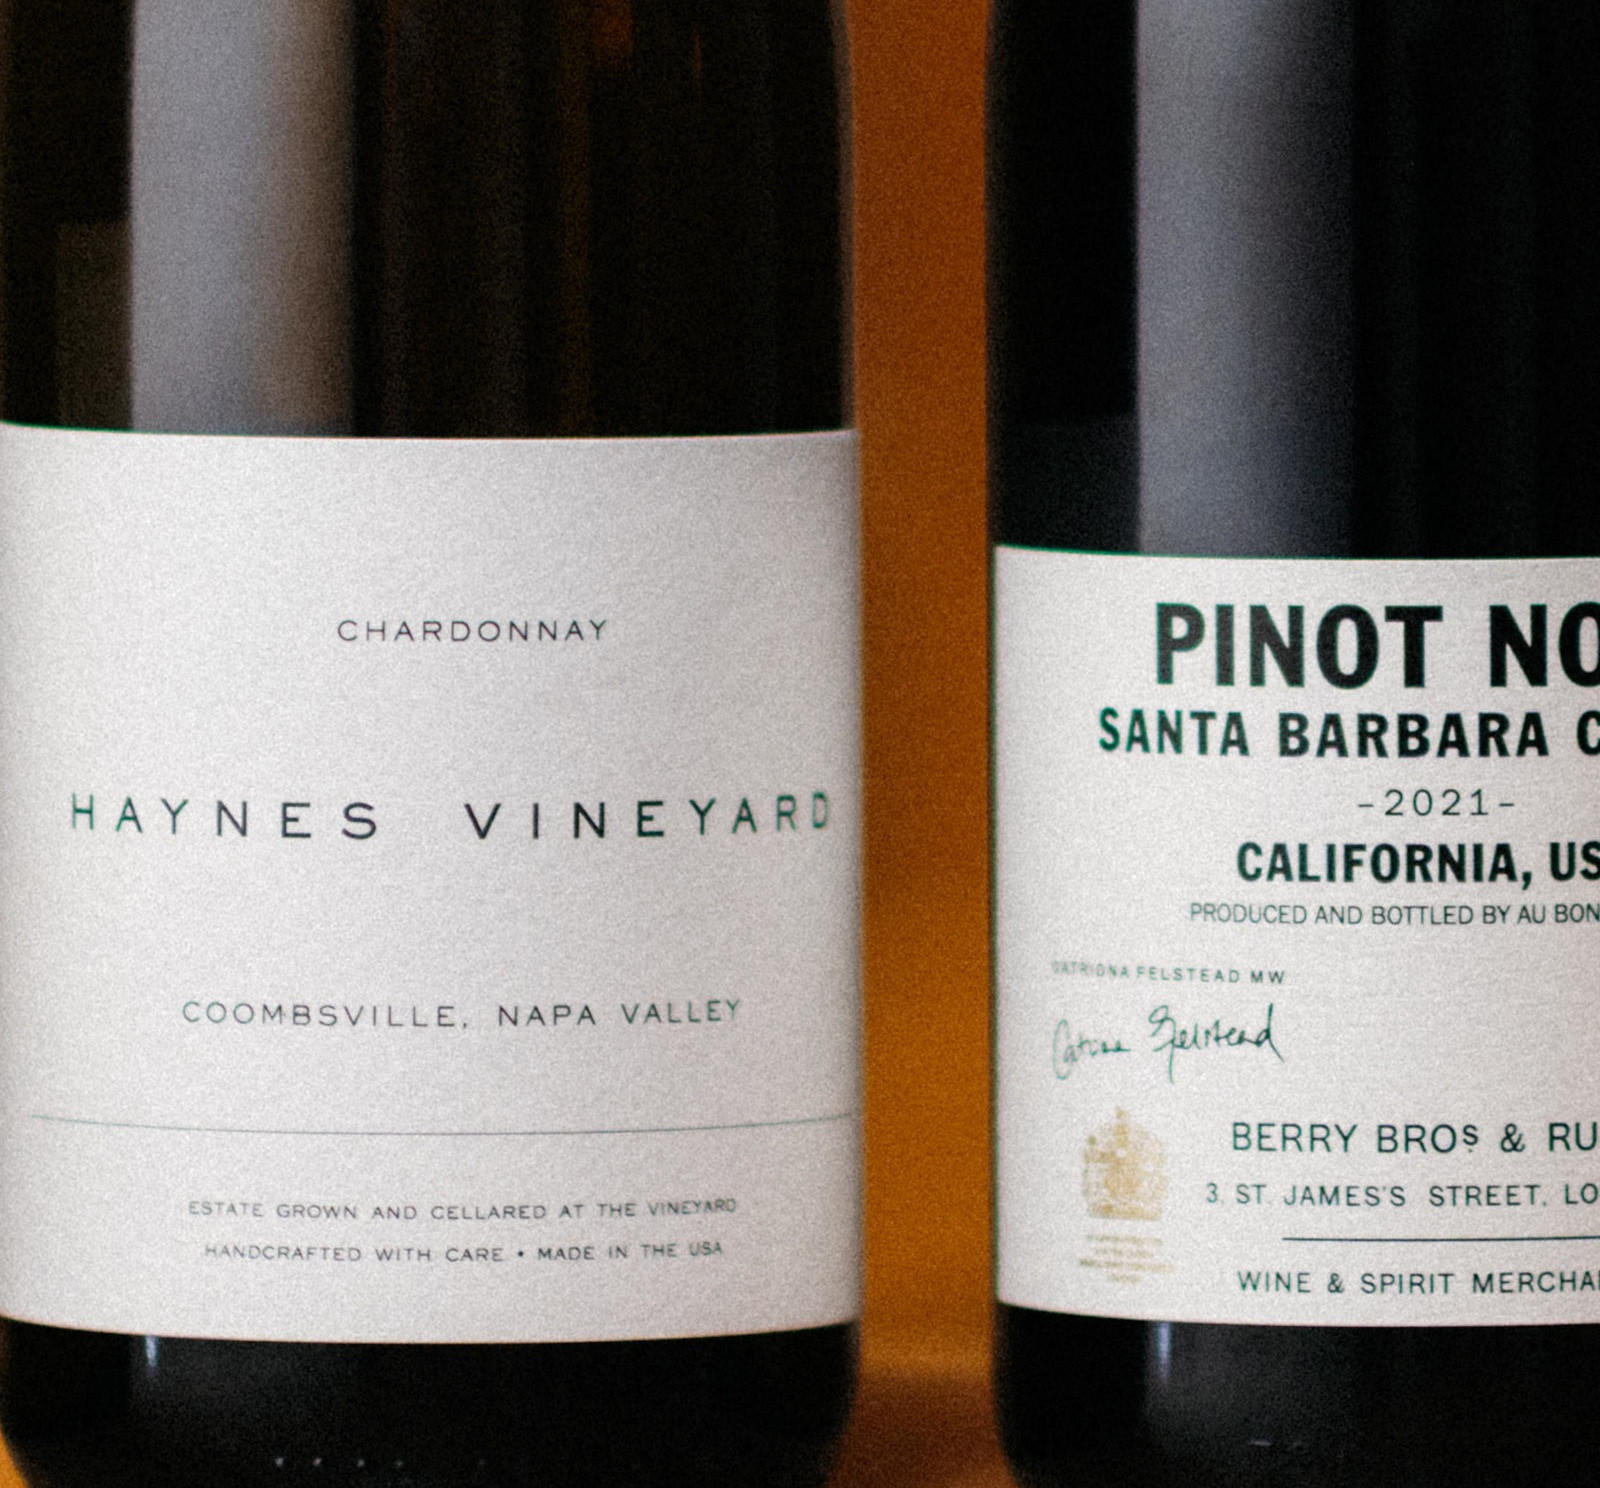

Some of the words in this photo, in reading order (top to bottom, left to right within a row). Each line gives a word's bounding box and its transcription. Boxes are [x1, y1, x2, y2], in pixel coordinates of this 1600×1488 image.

[337, 619, 608, 642] CHARDONNAY
[1158, 603, 1443, 689] PINOT
[1099, 707, 1249, 756] SANTA
[1280, 712, 1548, 757] BARBARA
[72, 795, 377, 840] HAYNES
[464, 792, 827, 840] VINEYARD
[1237, 842, 1532, 890] CALIFORNIA,
[1190, 902, 1308, 925] PRODUCED
[1315, 905, 1363, 925] AND
[1371, 905, 1474, 925] BOTTLED
[1482, 905, 1510, 924] BY
[1517, 905, 1546, 924] AU
[1554, 903, 1600, 923] BON
[1137, 966, 1239, 983] FELSTEAD
[1251, 971, 1283, 983] MW
[182, 1000, 468, 1029] COOMBSVILLE,
[498, 1004, 596, 1026] NAPA
[621, 999, 739, 1024] VALLEY
[1233, 1122, 1357, 1152] BERRY
[1500, 1124, 1525, 1152] &
[1284, 1185, 1405, 1207] JAMES'S
[189, 1201, 263, 1217] ESTATE
[276, 1204, 357, 1219] GROWN
[372, 1206, 417, 1220] AND
[431, 1205, 546, 1220] CELLARED
[560, 1204, 583, 1216] AT
[598, 1202, 635, 1217] THE
[649, 1198, 736, 1216] VINEYARD
[205, 1245, 362, 1262] HANDCRAFTED
[375, 1248, 431, 1261] WITH
[445, 1248, 501, 1262] CARE
[538, 1246, 592, 1260] MADE
[608, 1246, 627, 1258] IN
[642, 1243, 675, 1257] THE
[689, 1241, 722, 1256] USA
[1238, 1271, 1310, 1293] WINE
[1328, 1273, 1343, 1293] &
[1361, 1273, 1454, 1294] SPIRIT
